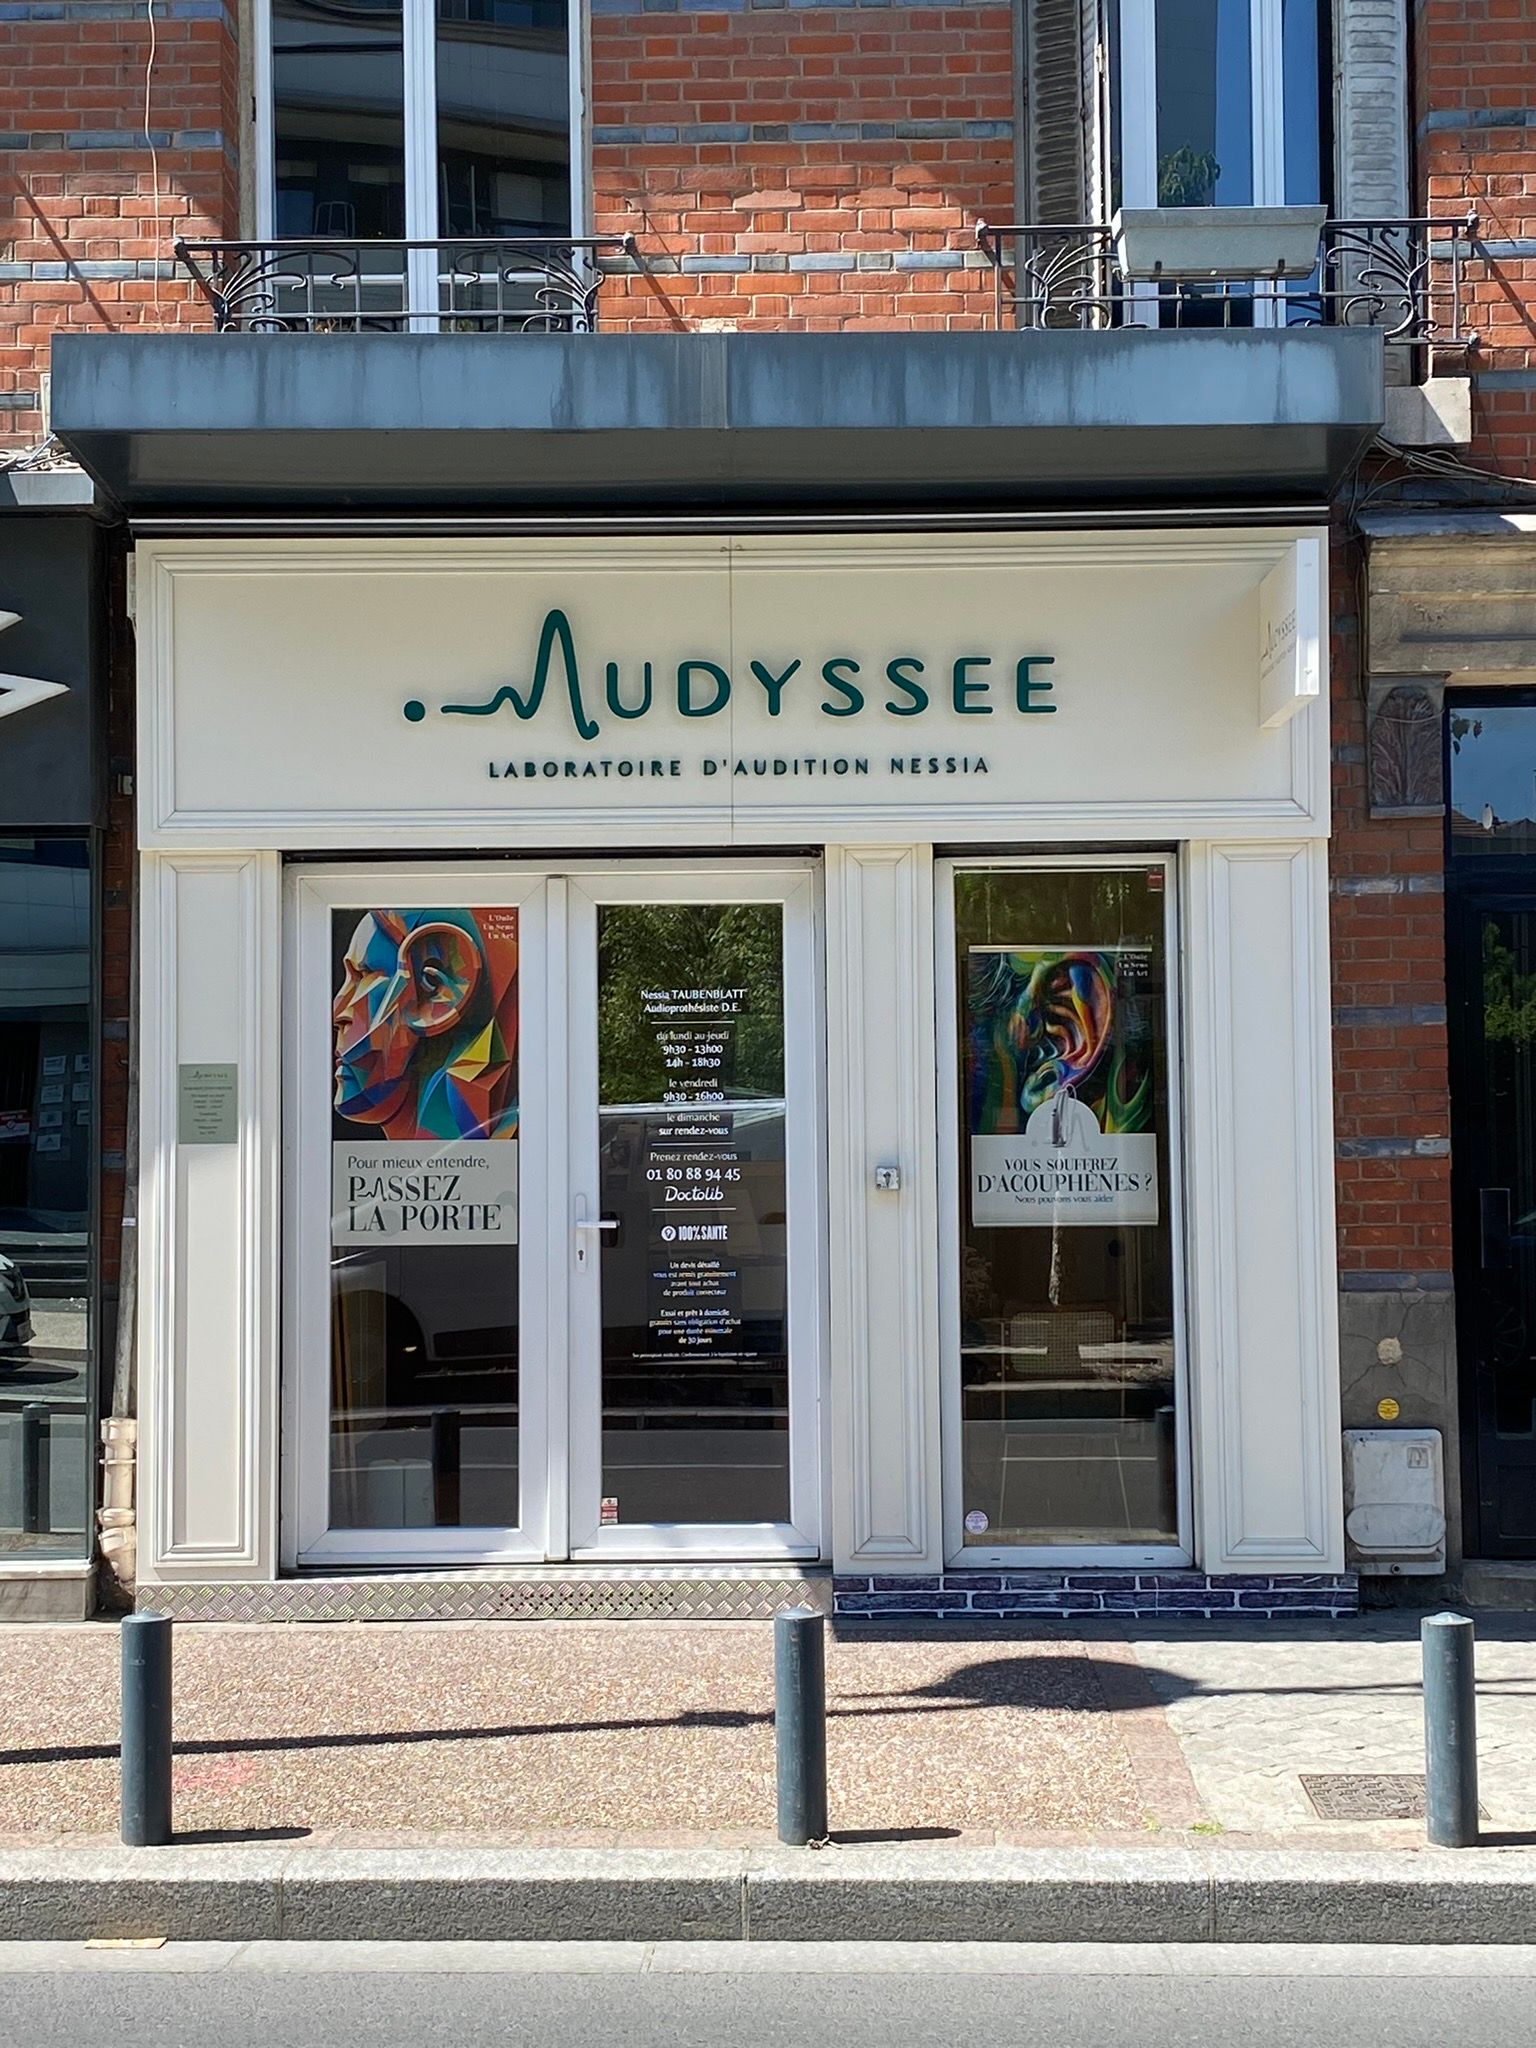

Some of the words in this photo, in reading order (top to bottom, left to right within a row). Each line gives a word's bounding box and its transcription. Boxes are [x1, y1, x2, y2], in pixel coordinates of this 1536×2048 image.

[488, 757, 683, 778] LABORATOIRE
[703, 757, 870, 777] D'AUDITION
[889, 756, 990, 776] NESSIA
[640, 990, 670, 1000] Nessia
[672, 989, 746, 1000] TAUBENBLATT
[643, 1003, 719, 1015] Audioprothésiste
[669, 1030, 692, 1040] lundi
[706, 1030, 730, 1042] jeudi
[662, 1044, 686, 1055] 9h30
[694, 1044, 723, 1055] 13h00
[665, 1057, 683, 1068] 14h
[691, 1057, 721, 1068] 18h30
[668, 1078, 677, 1088] le
[679, 1078, 718, 1088] vendredi
[663, 1091, 687, 1102] 9h30
[694, 1091, 724, 1101] 16h00
[666, 1112, 675, 1122] le
[676, 1112, 720, 1122] dimanche
[658, 1127, 673, 1136] sur
[674, 1125, 729, 1136] rendez-vous
[347, 1155, 378, 1169] Pour
[382, 1157, 422, 1169] mieux
[426, 1155, 490, 1170] entendre,
[650, 1152, 681, 1162] Prenez
[683, 1151, 738, 1161] rendez-vous
[1004, 1158, 1041, 1171] VOUS
[1046, 1157, 1119, 1171] SOUFFREZ
[646, 1169, 663, 1180] 01
[666, 1167, 683, 1180] 80
[685, 1167, 702, 1180] 88
[704, 1168, 721, 1181] 94
[724, 1168, 741, 1181] 45
[977, 1170, 1140, 1193] D'ACOUPHÈNES
[347, 1175, 461, 1202] PASSEZ
[664, 1185, 724, 1201] Doctolib
[1015, 1195, 1035, 1203] Nous
[347, 1204, 387, 1232] LA
[400, 1203, 501, 1231] PORTE
